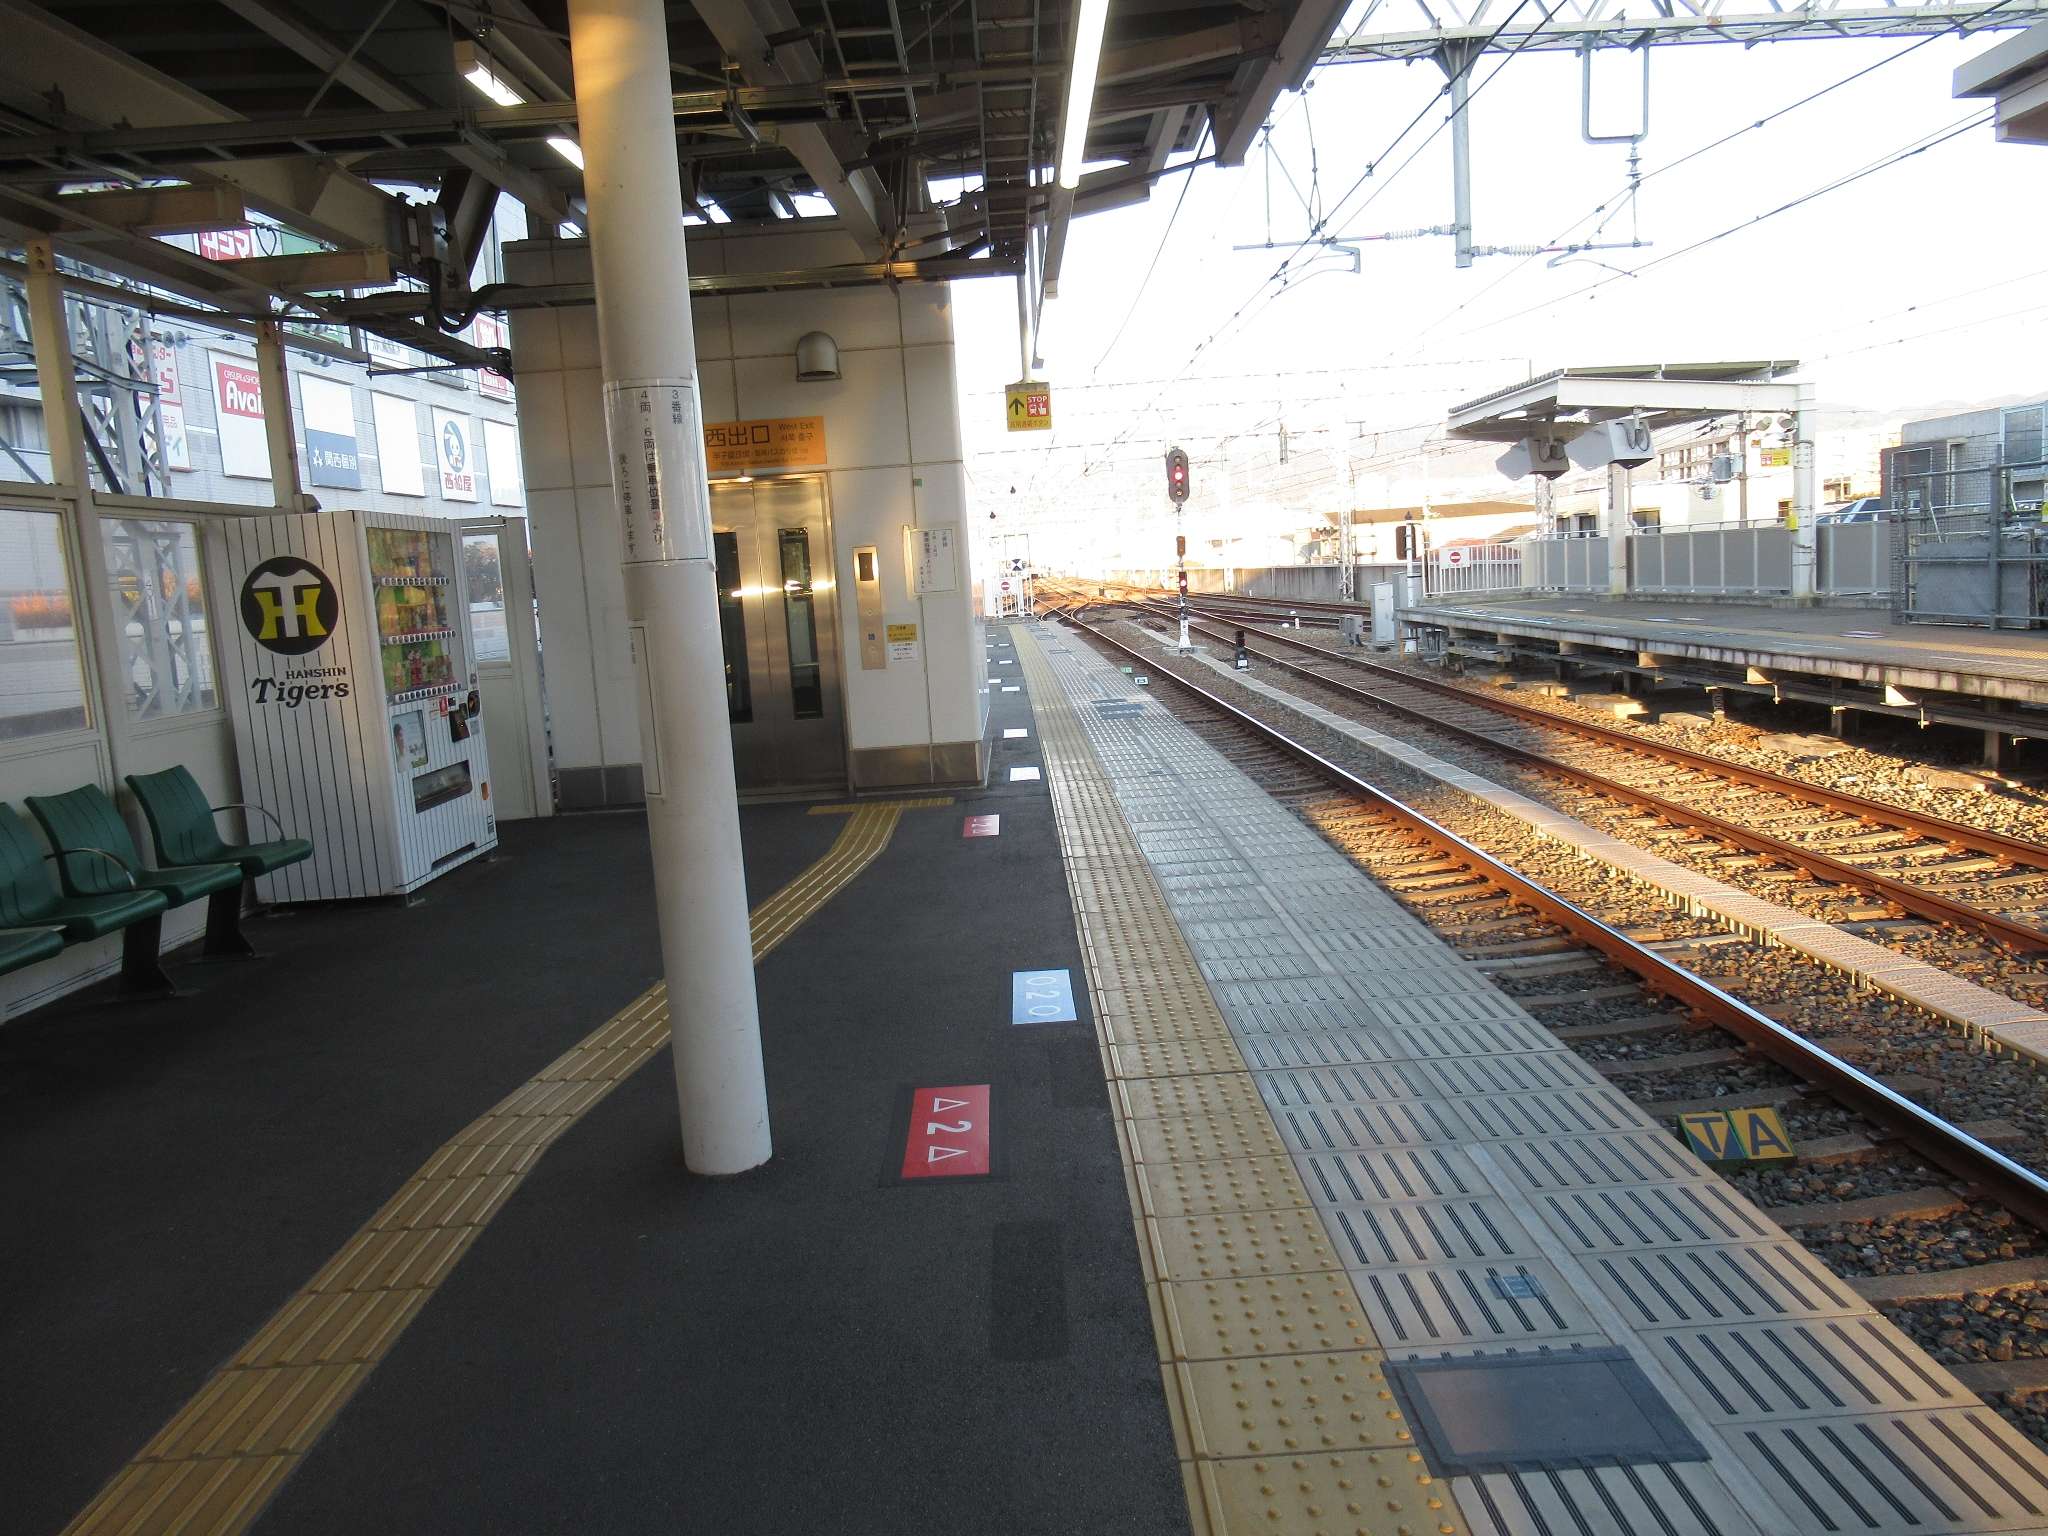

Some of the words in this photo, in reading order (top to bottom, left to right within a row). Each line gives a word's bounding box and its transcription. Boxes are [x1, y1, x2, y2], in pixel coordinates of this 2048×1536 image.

[226, 381, 264, 414] Avai
[672, 389, 683, 425] 3番線
[1028, 395, 1047, 403] STOP
[706, 424, 769, 447] 西出口
[777, 422, 798, 431] West
[443, 471, 473, 493] 西松屋
[285, 666, 347, 680] HANSHIN
[252, 677, 350, 709] Tigers
